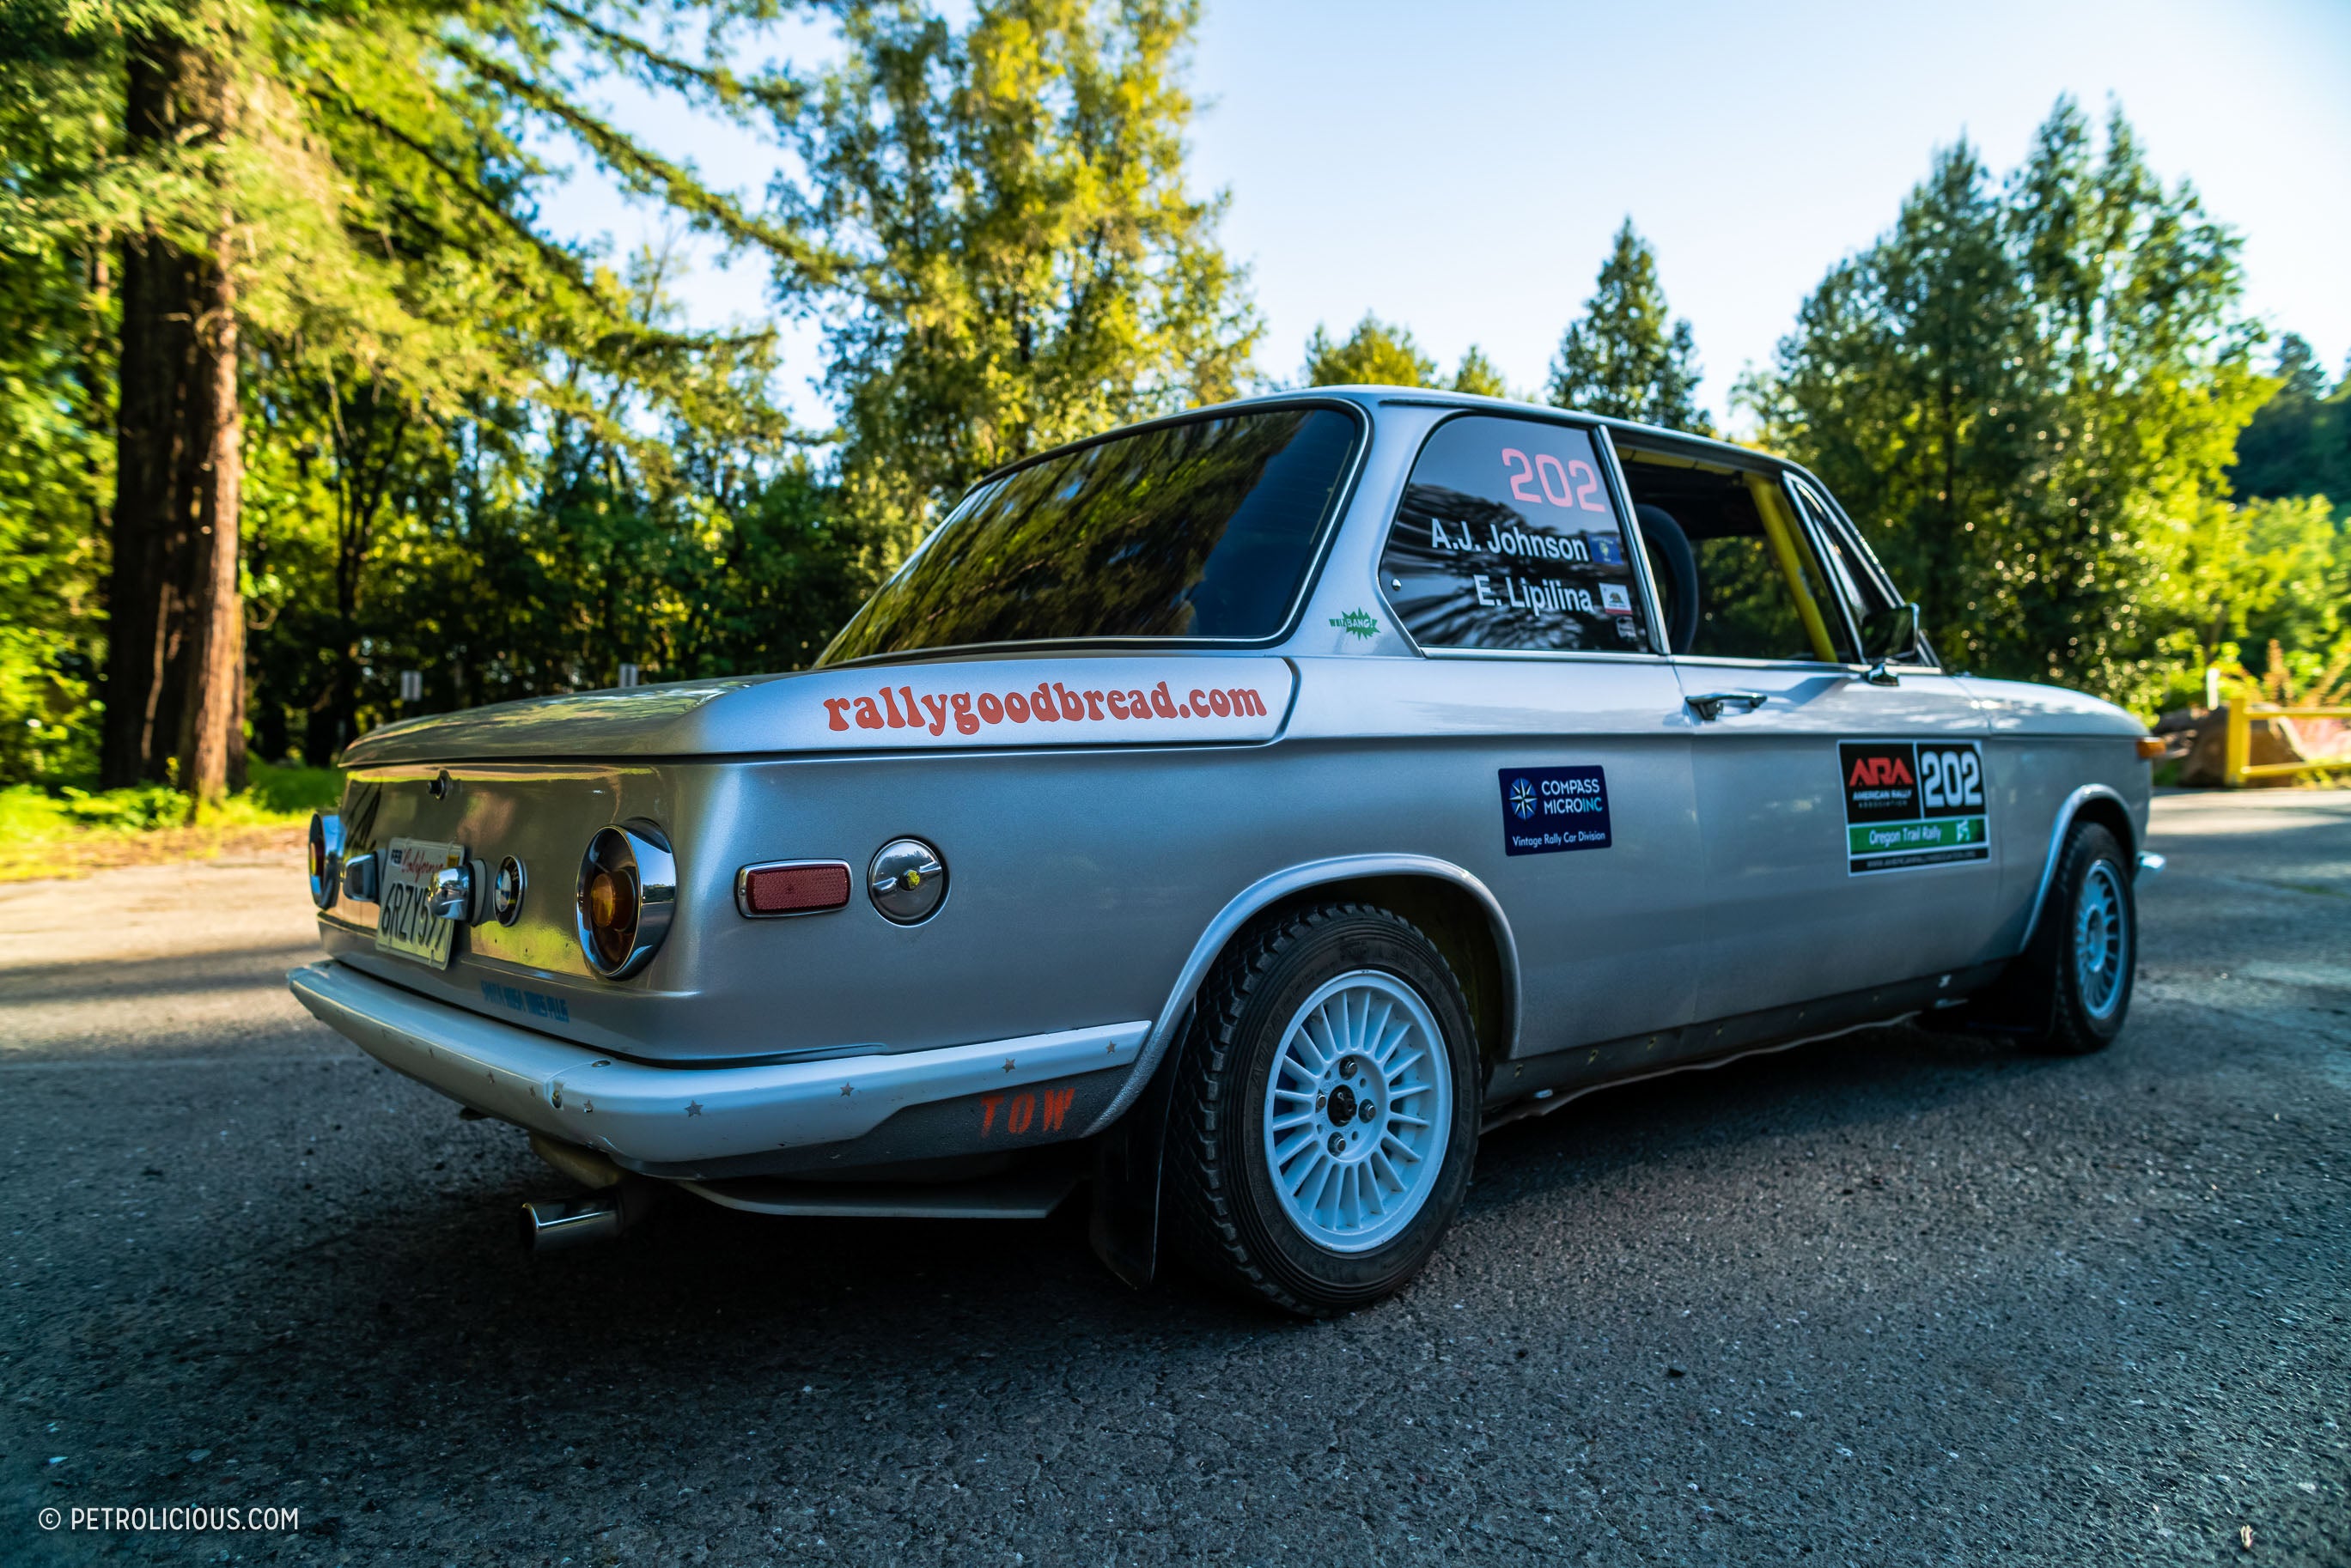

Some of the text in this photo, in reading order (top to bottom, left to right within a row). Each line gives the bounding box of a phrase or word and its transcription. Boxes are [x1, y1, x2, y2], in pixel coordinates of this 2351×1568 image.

[1501, 447, 1605, 513] 202
[1432, 519, 1588, 562] A.J. Johnson
[1473, 574, 1501, 606] E.
[823, 681, 1267, 737] rallygoodbread.com
[1542, 779, 1599, 795] COMPASS
[1849, 757, 1914, 787] ARA
[1921, 751, 1983, 807] 202
[1513, 830, 1605, 848] Vintage Rally Car Division
[1869, 825, 1941, 848] Oregon Trail Rally
[981, 1088, 1075, 1139] TOW
